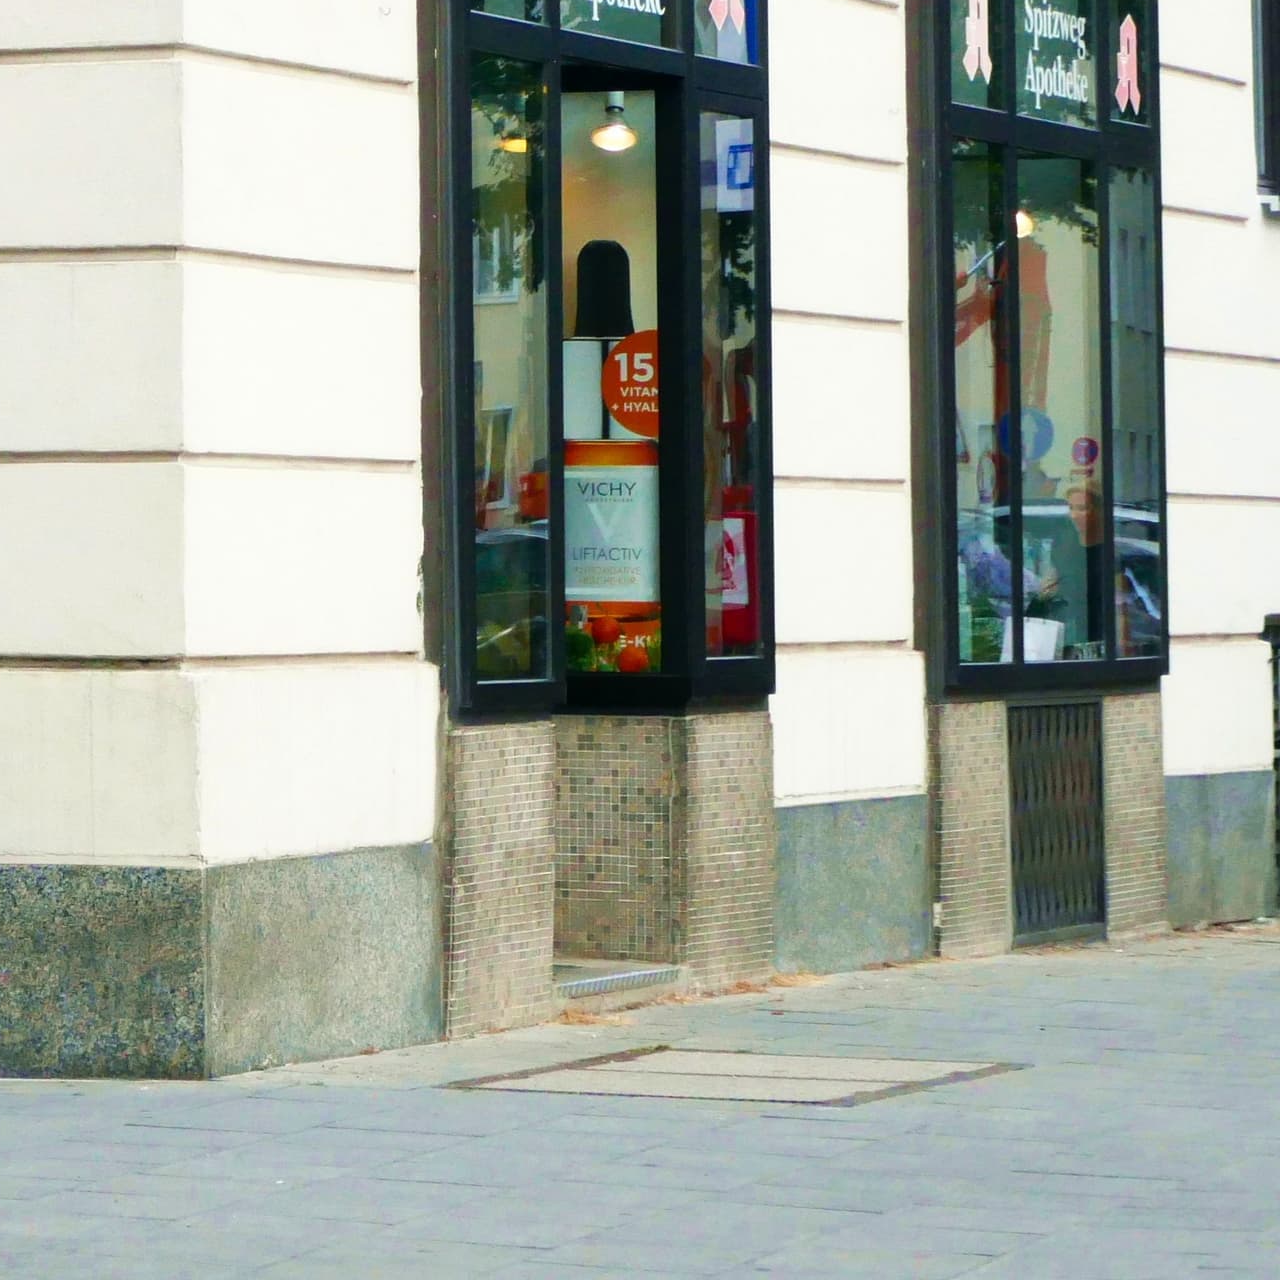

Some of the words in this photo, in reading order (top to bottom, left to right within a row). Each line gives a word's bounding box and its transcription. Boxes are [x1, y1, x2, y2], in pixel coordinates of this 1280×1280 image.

[1023, 48, 1089, 110] Apotheke
[614, 352, 655, 383] 15
[577, 482, 636, 496] VICHY
[572, 547, 642, 561] LIFTACTIV
